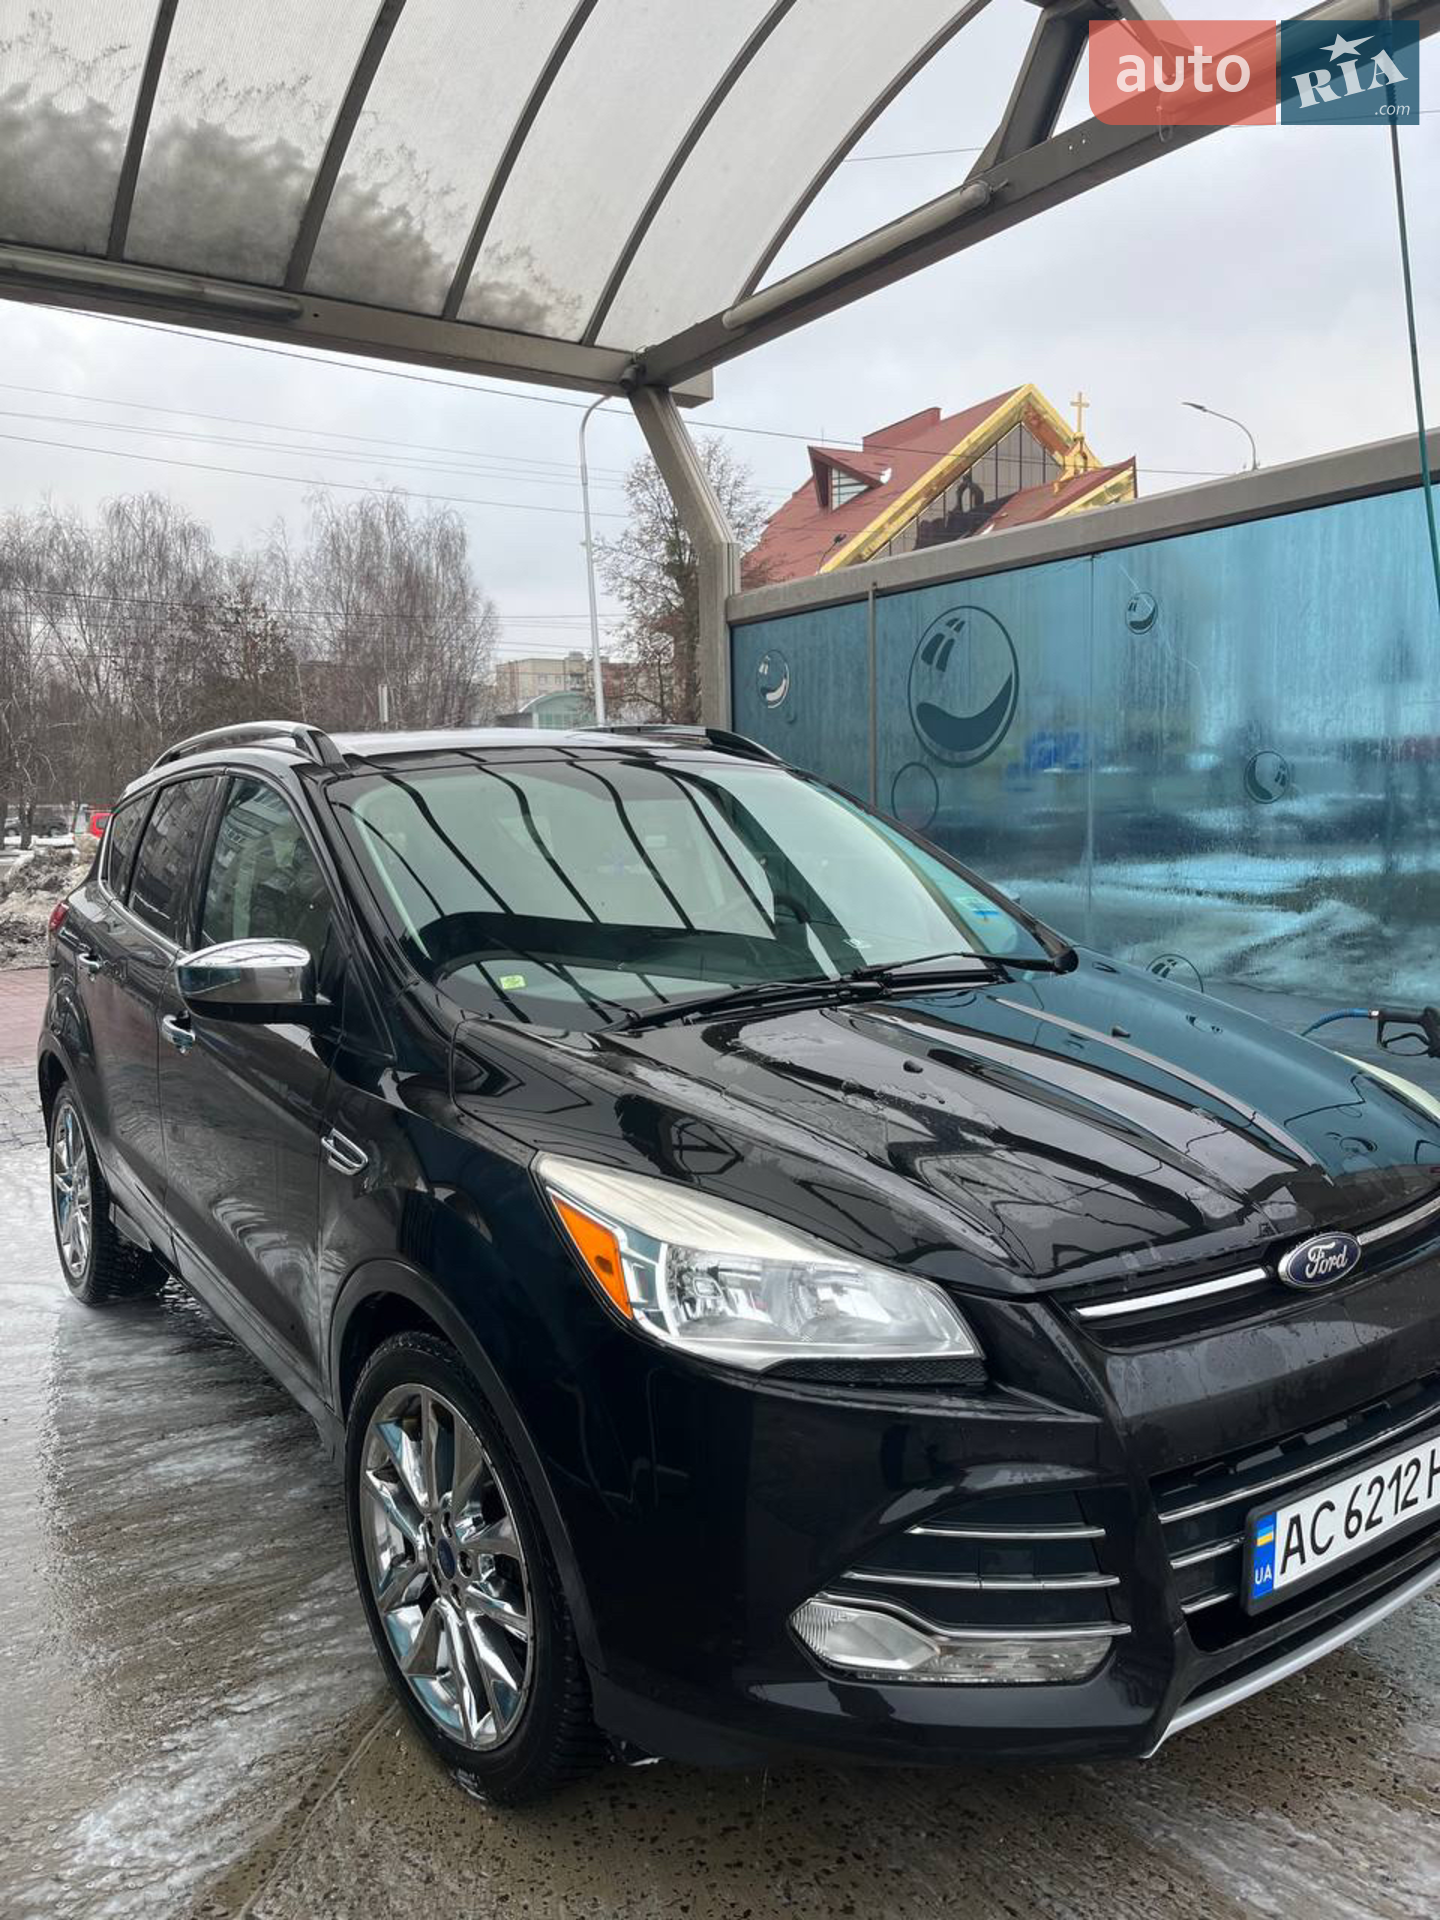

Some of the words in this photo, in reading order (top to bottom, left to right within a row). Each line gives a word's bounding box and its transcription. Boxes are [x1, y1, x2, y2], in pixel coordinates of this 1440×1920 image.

[1305, 1241, 1348, 1279] Ford
[1343, 1457, 1422, 1540] 6212
[1254, 1564, 1273, 1585] UA
